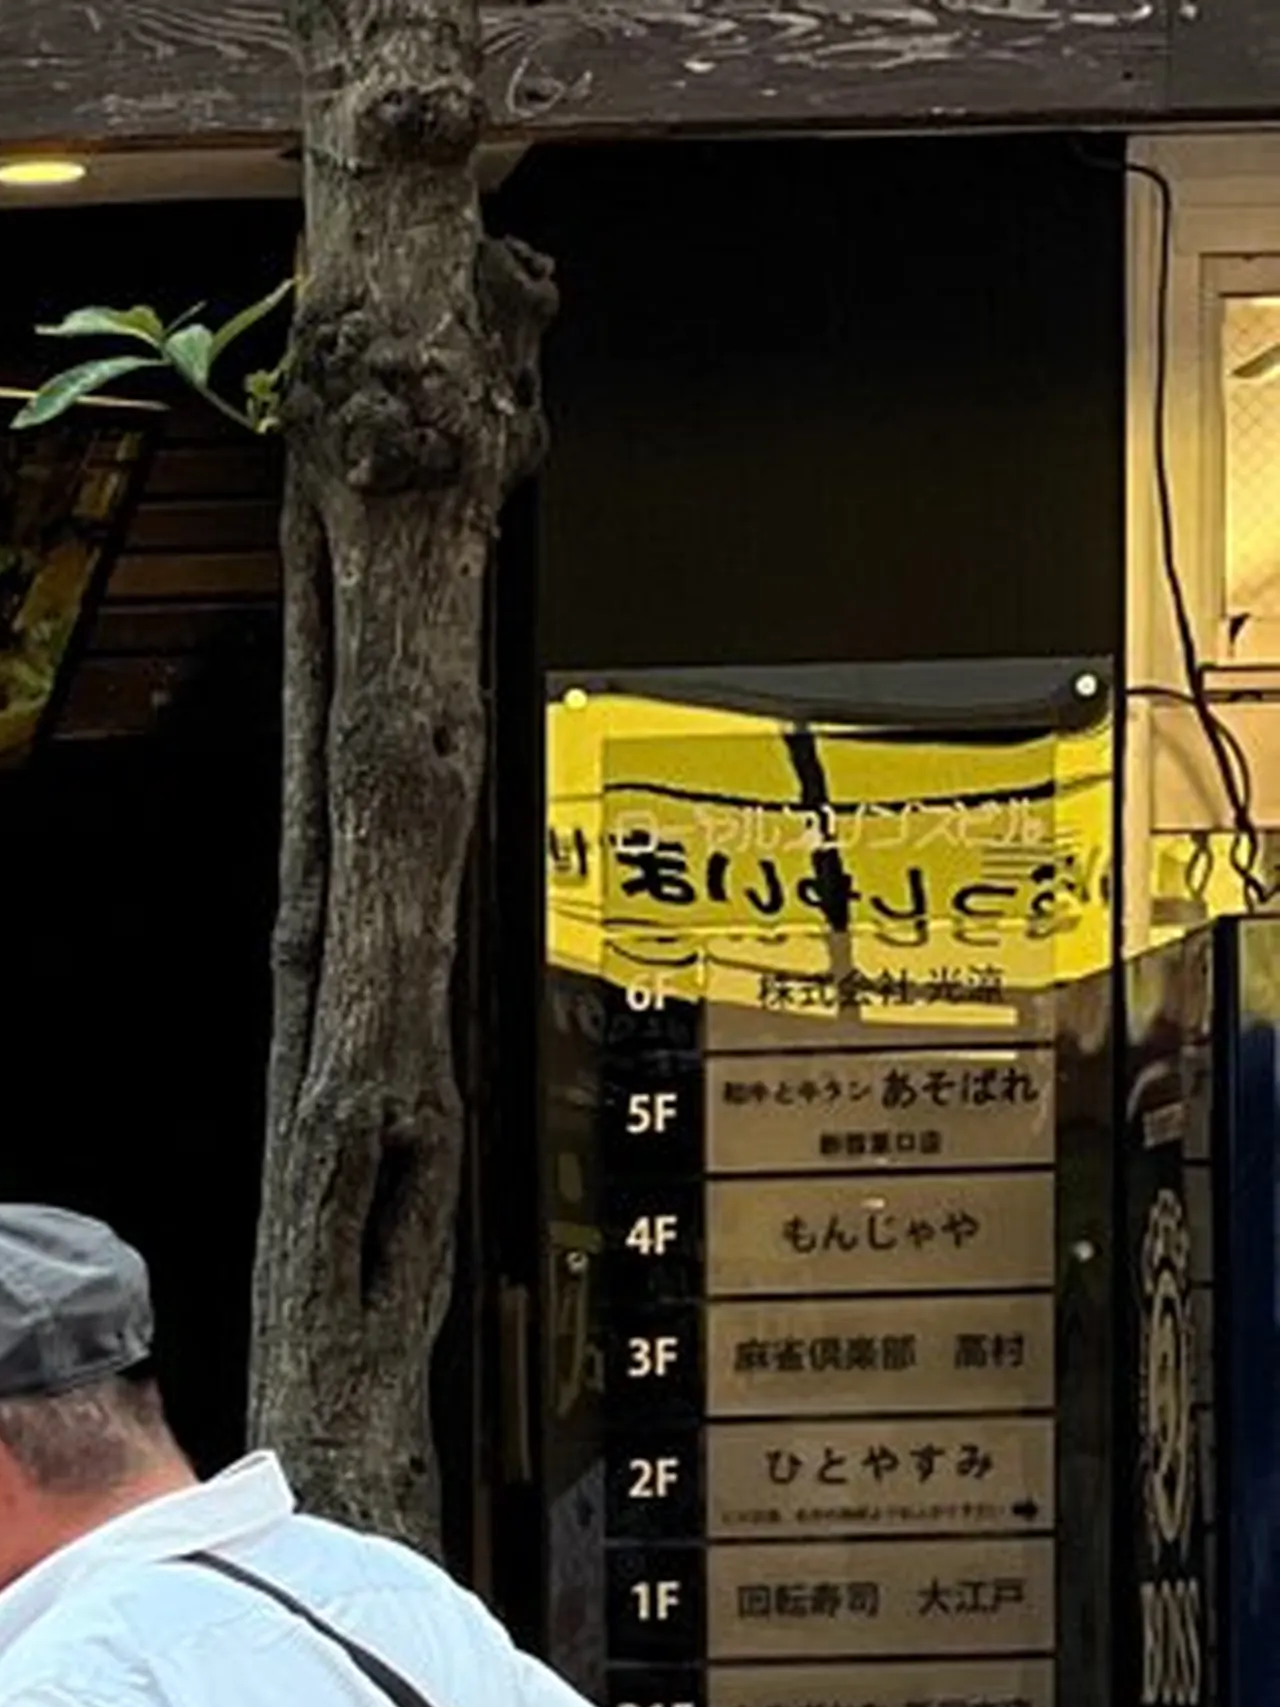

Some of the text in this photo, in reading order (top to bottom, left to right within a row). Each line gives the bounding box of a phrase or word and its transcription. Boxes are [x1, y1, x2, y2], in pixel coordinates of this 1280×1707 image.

[882, 1067, 1040, 1109] あそばれ
[626, 1093, 678, 1134] 5F
[626, 1214, 678, 1252] 4F
[781, 1211, 980, 1250] もんじゃや
[627, 1336, 679, 1378] 3F
[628, 1458, 679, 1498] 2F
[765, 1443, 995, 1484] ひとやすみ
[631, 1581, 681, 1620] 1F
[916, 1578, 1028, 1617] 大江戸
